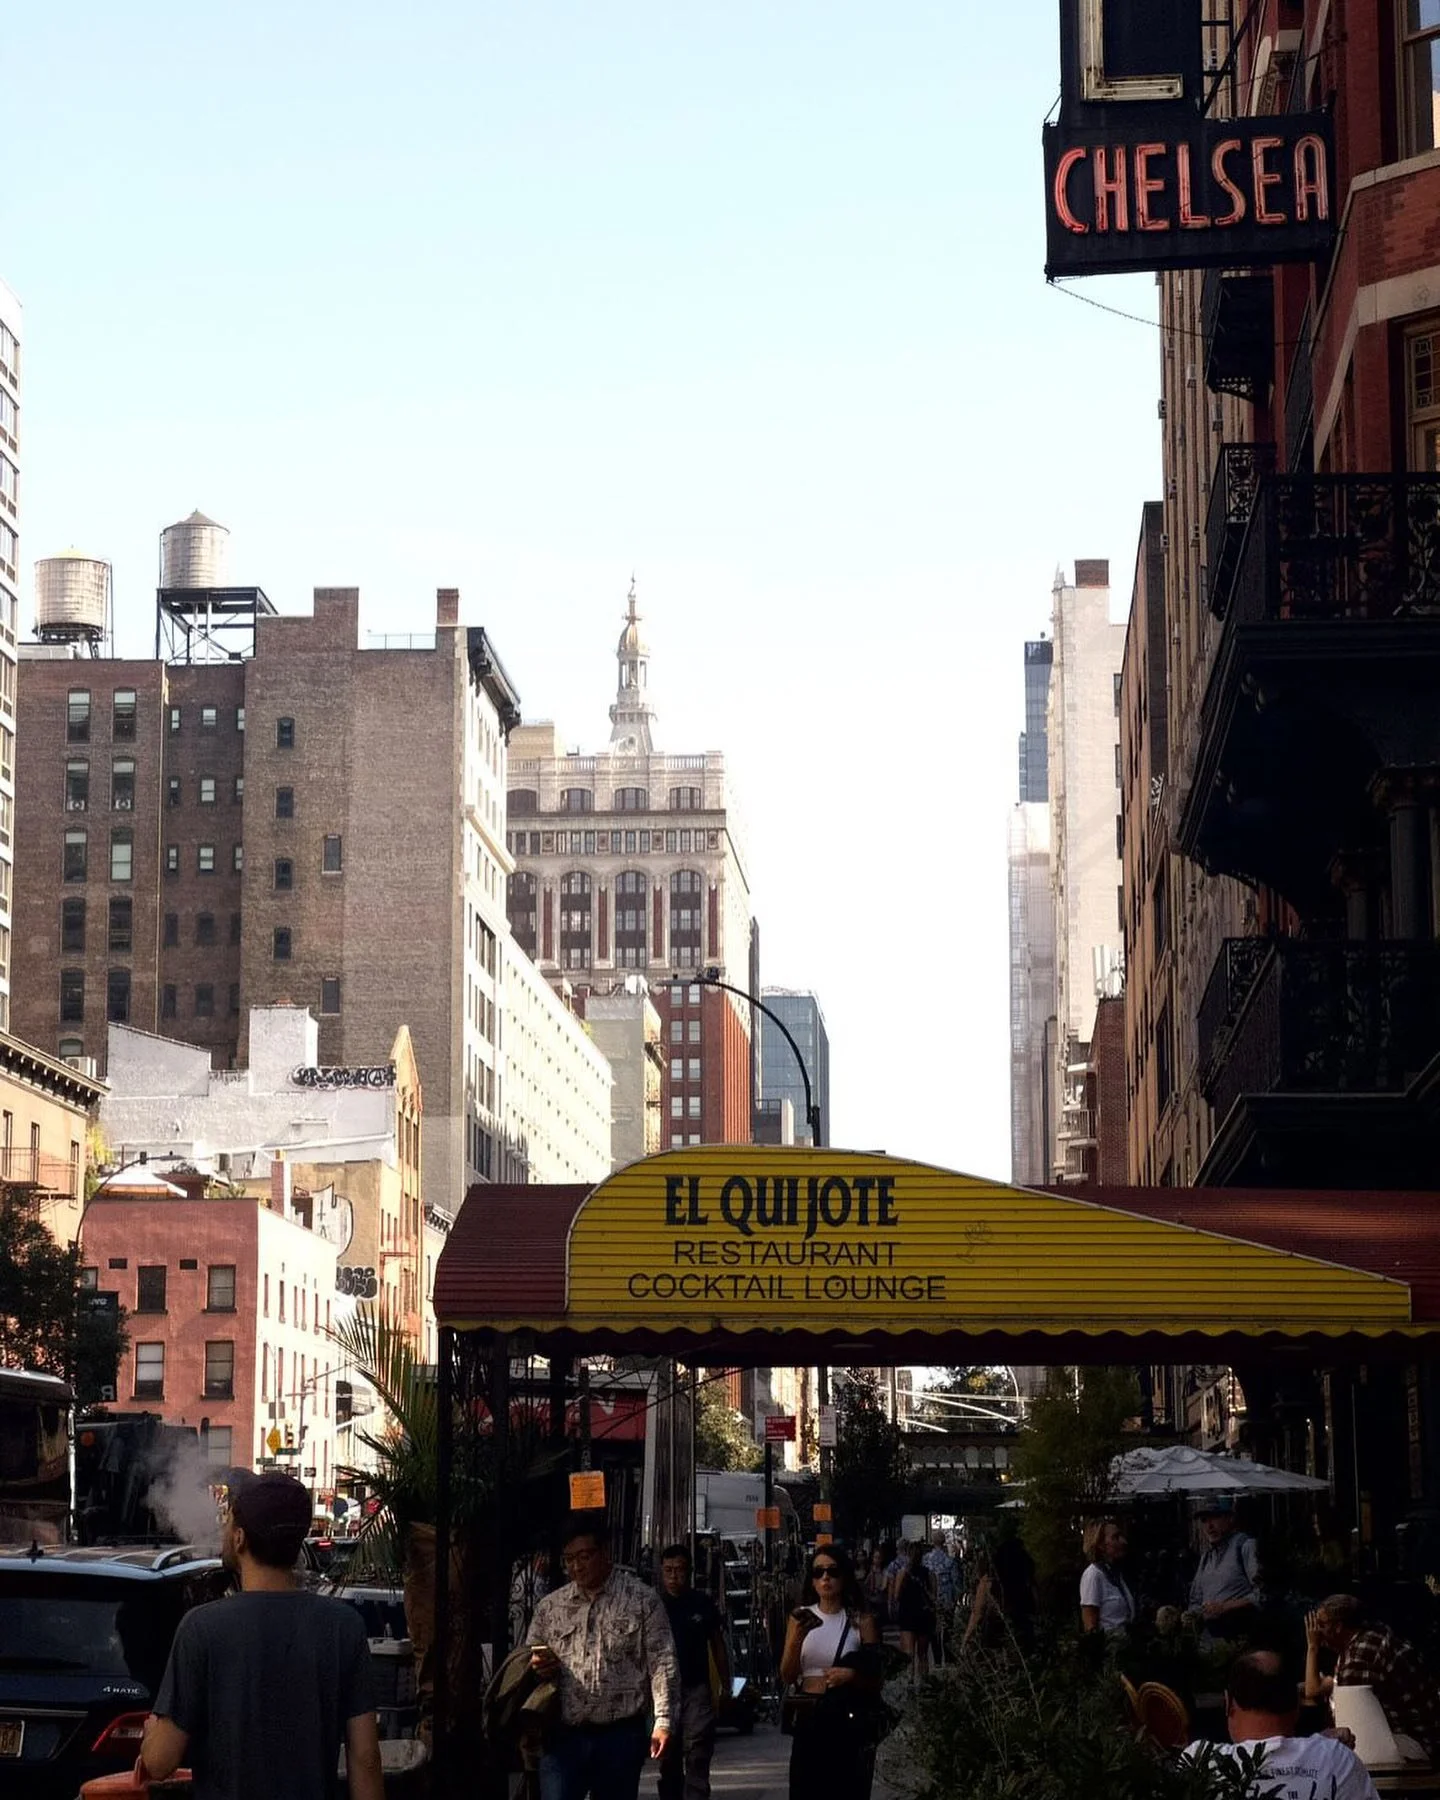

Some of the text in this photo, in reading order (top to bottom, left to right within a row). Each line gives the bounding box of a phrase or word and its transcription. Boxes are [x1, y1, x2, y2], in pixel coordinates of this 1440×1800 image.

[1054, 134, 1330, 233] CHELSEA
[664, 1175, 899, 1241] EL QUIJOTE
[673, 1240, 901, 1266] RESTAURANT
[627, 1273, 947, 1300] COCKTAIL LOUNGE
